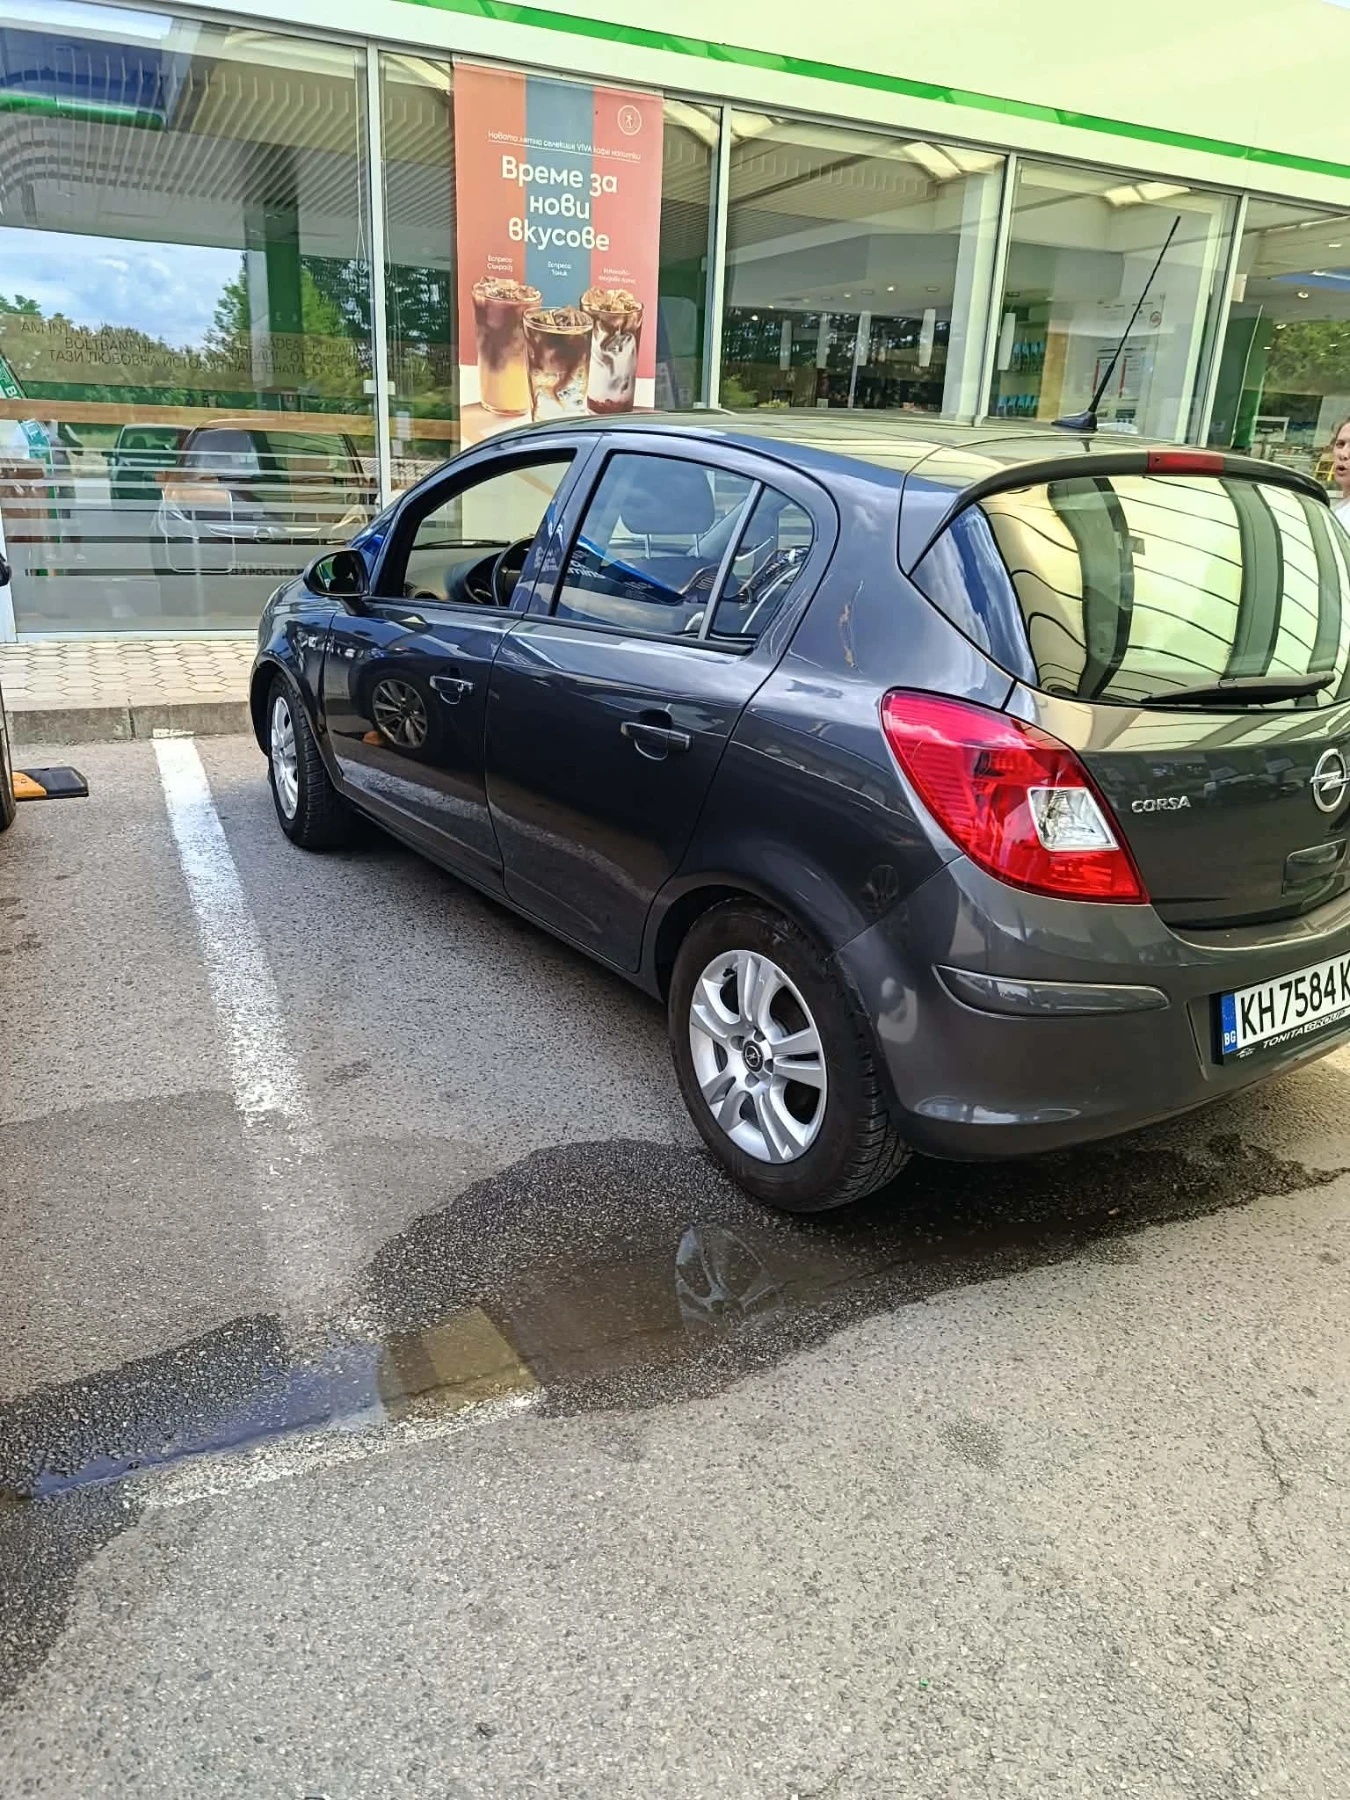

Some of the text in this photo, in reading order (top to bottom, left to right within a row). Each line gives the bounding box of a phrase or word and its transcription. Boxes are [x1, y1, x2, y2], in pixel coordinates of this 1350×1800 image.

[577, 143, 592, 153] VIVA
[501, 155, 618, 197] Време за
[529, 193, 590, 220] нови
[508, 216, 610, 251] вкусове
[49, 349, 84, 363] ТАЗИ
[162, 356, 224, 371] ИСТО
[1131, 795, 1192, 814] CORSA
[1224, 1030, 1237, 1046] BG
